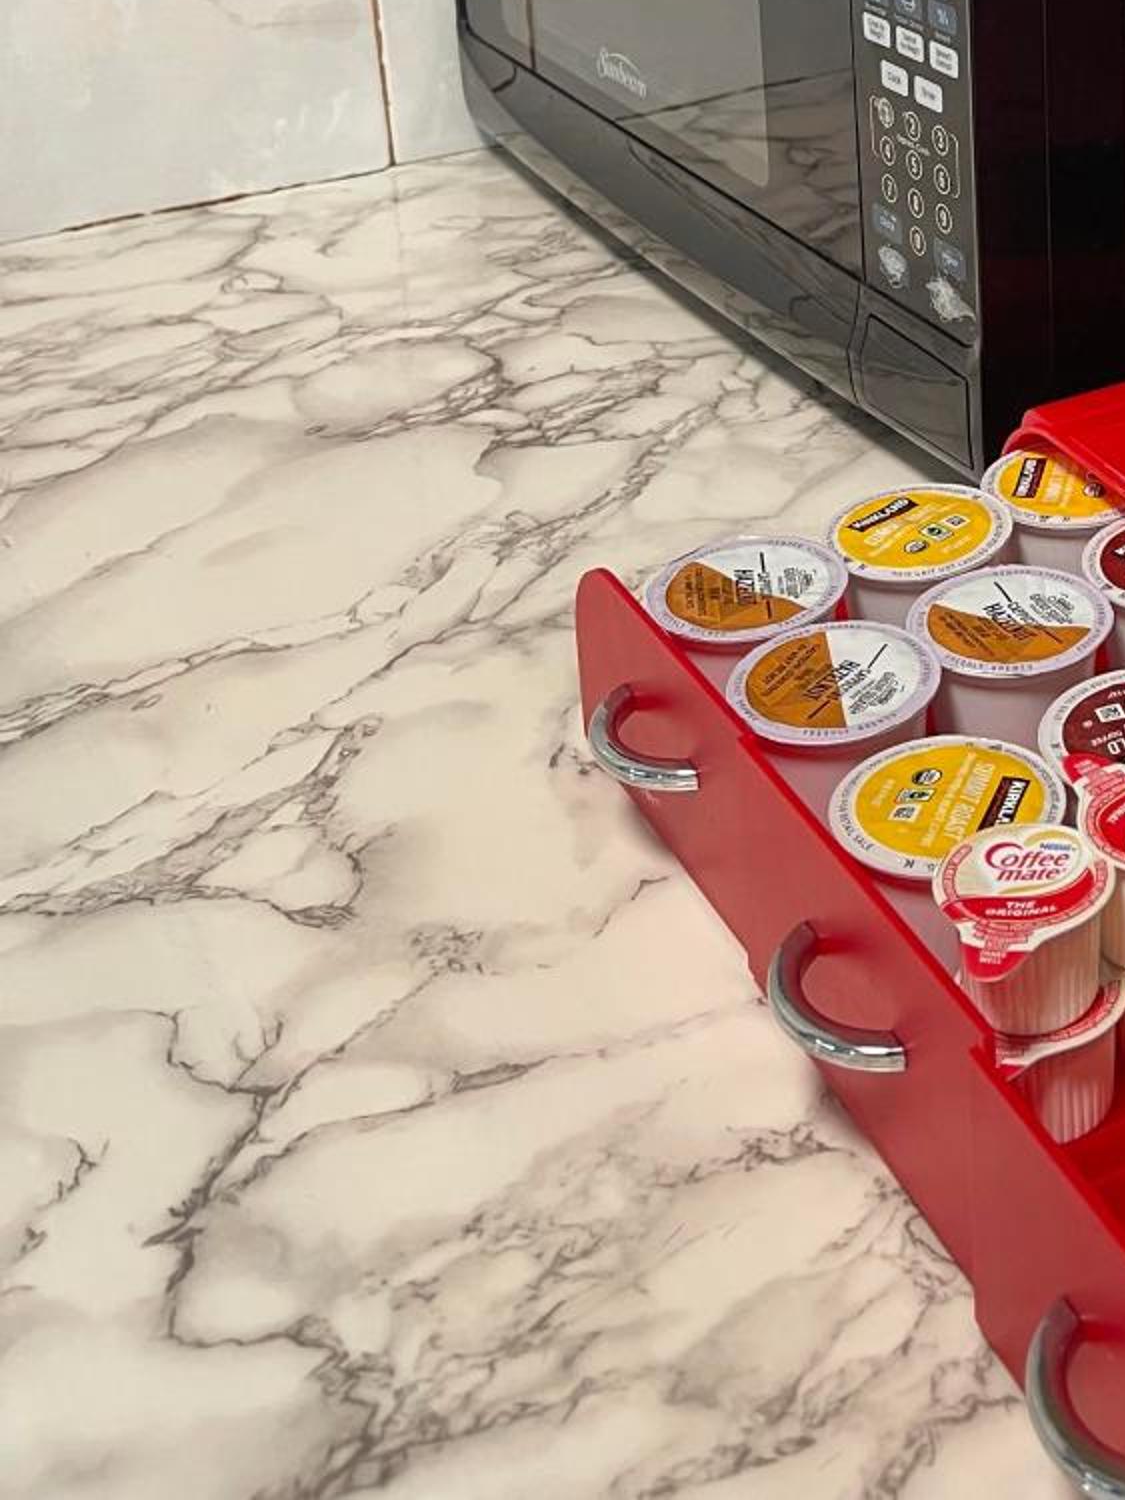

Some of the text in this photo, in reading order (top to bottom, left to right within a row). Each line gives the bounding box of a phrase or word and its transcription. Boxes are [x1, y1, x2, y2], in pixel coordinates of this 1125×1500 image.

[996, 780, 1028, 825] KIRKLA
[984, 841, 1070, 871] Coffee
[997, 866, 1061, 882] mate
[985, 905, 1057, 917] ORIGINAL
[1005, 901, 1036, 909] THE
